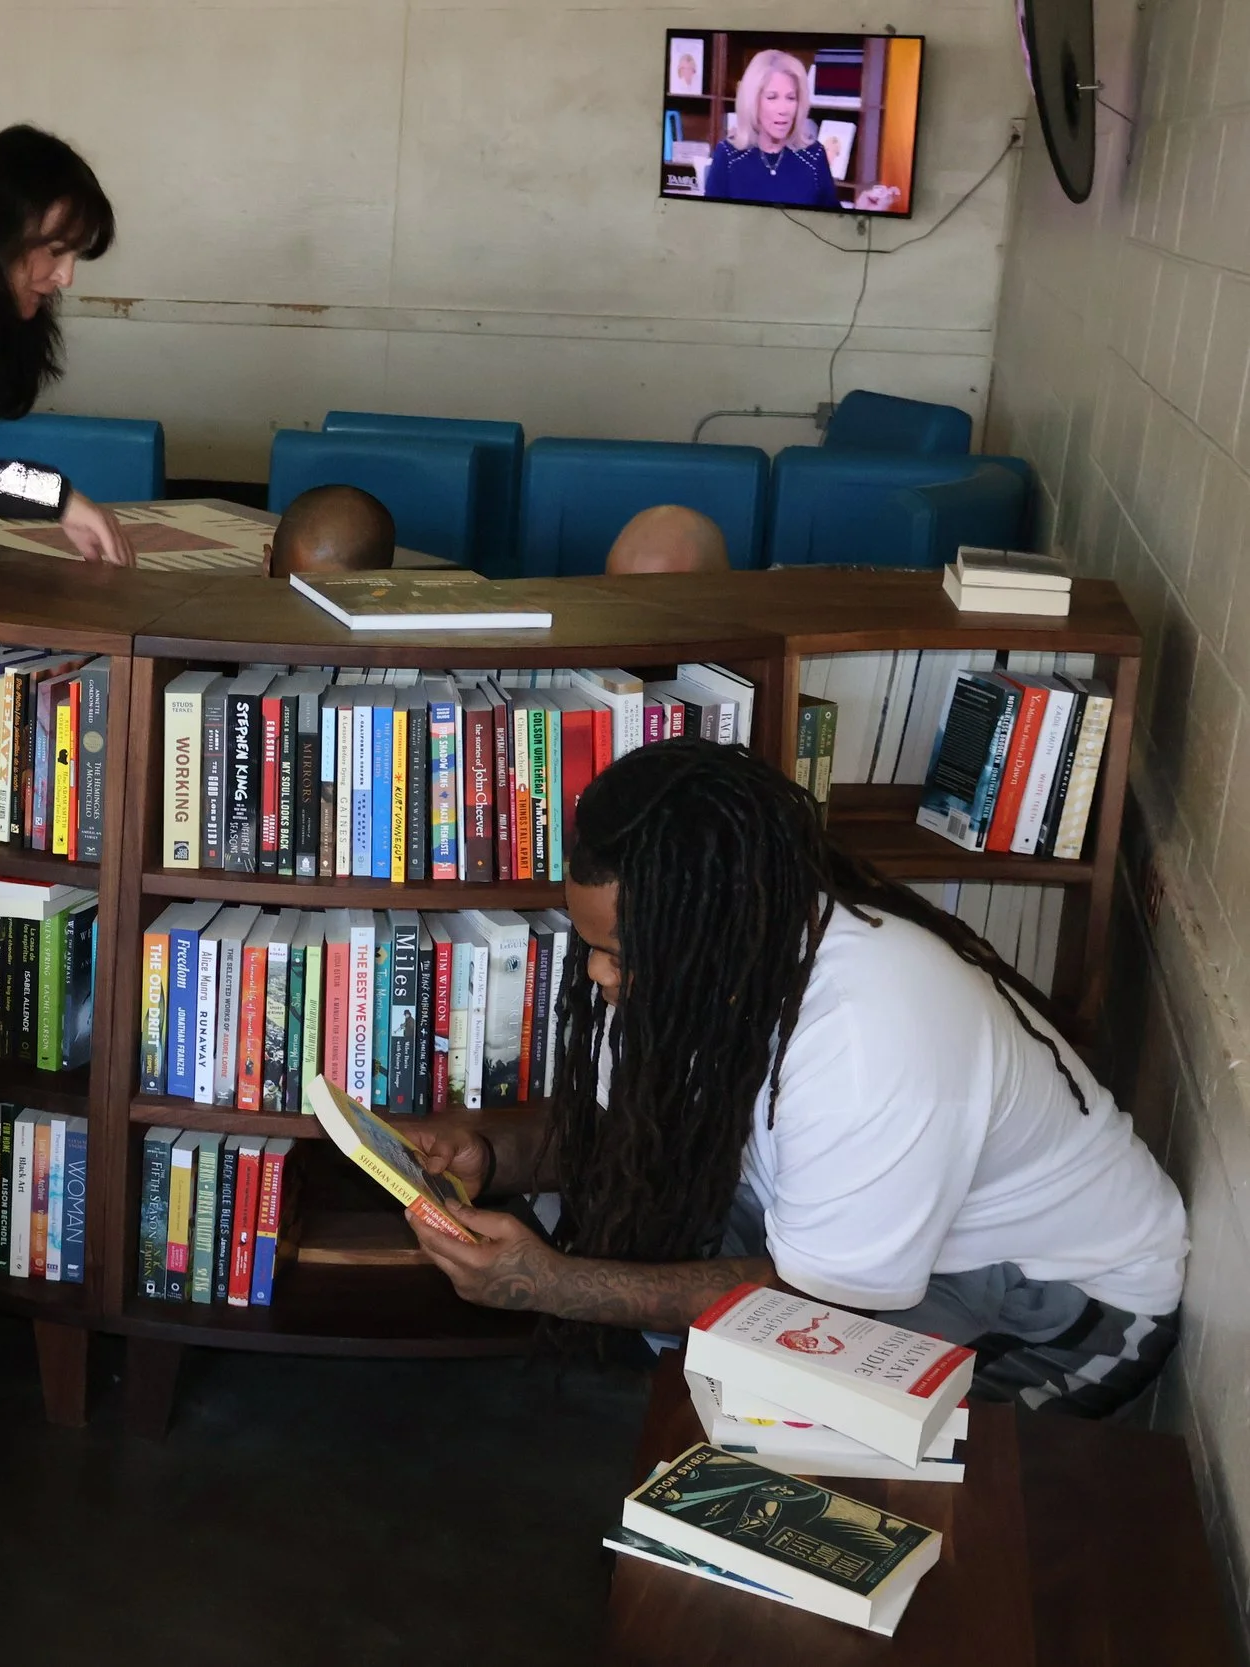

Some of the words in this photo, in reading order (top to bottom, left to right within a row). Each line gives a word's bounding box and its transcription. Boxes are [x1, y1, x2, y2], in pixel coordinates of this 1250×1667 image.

[0, 673, 14, 786] HEAVY
[235, 701, 250, 760] STEPHEN
[533, 712, 543, 745] COLSON
[650, 714, 659, 737] PHILIP
[672, 712, 682, 730] BIRD
[1053, 705, 1063, 727] ZADIE
[266, 720, 275, 762] ERASURE
[439, 726, 448, 738] THE
[517, 717, 526, 748] Chinua
[1046, 731, 1057, 755] SMITH
[282, 761, 290, 775] MY
[439, 740, 448, 769] SHADOW
[475, 759, 483, 767] of
[517, 750, 526, 779] Achebe
[175, 737, 190, 823] WORKING
[234, 764, 250, 801] KING
[302, 743, 312, 804] MIRRORS
[439, 771, 448, 788] KING
[471, 766, 487, 792] John
[533, 747, 544, 794] WHITEHEAD
[85, 767, 93, 818] MONTICELLO
[93, 778, 101, 820] HEMINGSES
[207, 776, 219, 796] GOOD
[281, 776, 290, 797] SOUL
[394, 785, 403, 810] KURT
[280, 799, 290, 826] LOOKS
[340, 797, 348, 843] GAINES
[440, 802, 449, 824] MAAZA
[475, 792, 487, 837] Cheever
[519, 799, 527, 826] THINGS
[207, 823, 217, 845] BIRD
[229, 822, 238, 854] SEASONS
[241, 822, 250, 855] DIFFERENT
[280, 828, 289, 850] BACK
[394, 813, 402, 862] VONNEGUT
[440, 825, 449, 855] MENGISTE
[519, 827, 528, 845] FALL
[535, 808, 544, 859] INTUITIONIST
[520, 847, 529, 869] APART
[43, 948, 51, 976] SPRING
[150, 944, 162, 970] THE
[176, 939, 191, 988] Freedom
[201, 951, 212, 971] Alice
[357, 944, 368, 969] THE
[394, 932, 416, 997] Miles
[439, 950, 448, 971] TIM
[23, 970, 31, 996] ISABEL
[148, 974, 162, 1003] OLD
[200, 975, 211, 1001] Munro
[225, 962, 233, 997] SELECTED
[356, 971, 367, 1000] BEST
[377, 969, 387, 986] Toni
[356, 1003, 366, 1021] WE
[376, 988, 387, 1019] Morrison
[438, 975, 447, 1022] WINTON
[22, 997, 30, 1032] ALLENDE
[148, 1007, 160, 1047] DRIFT
[177, 1007, 186, 1043] JONATHAN
[223, 1023, 230, 1032] OF
[198, 1011, 207, 1068] RUNAWAY
[355, 1024, 366, 1067] COULD
[176, 1044, 185, 1076] FRANZEN
[354, 1071, 365, 1090] DO
[3, 1122, 11, 1134] FUN
[2, 1136, 10, 1153] HOME
[18, 1157, 27, 1178] Black
[150, 1161, 163, 1192] FIFTH
[223, 1154, 234, 1180] BLACK
[359, 1154, 390, 1183] SHERMAN
[390, 1181, 413, 1202] ALEXIE
[1, 1177, 9, 1208] ALISON
[18, 1180, 26, 1193] Art
[222, 1183, 231, 1205] HOLE
[66, 1160, 86, 1243] WOMAN
[198, 1190, 215, 1214] DEREK
[0, 1209, 8, 1246] BECHDEL
[148, 1195, 161, 1239] SEASON
[220, 1208, 231, 1235] BLUES
[736, 1296, 786, 1333] CHILDREN
[854, 1329, 913, 1377] RUSHDIE
[883, 1339, 939, 1382] SALMAN
[676, 1451, 712, 1477] TOBIAS
[648, 1475, 680, 1500] WOLFF
